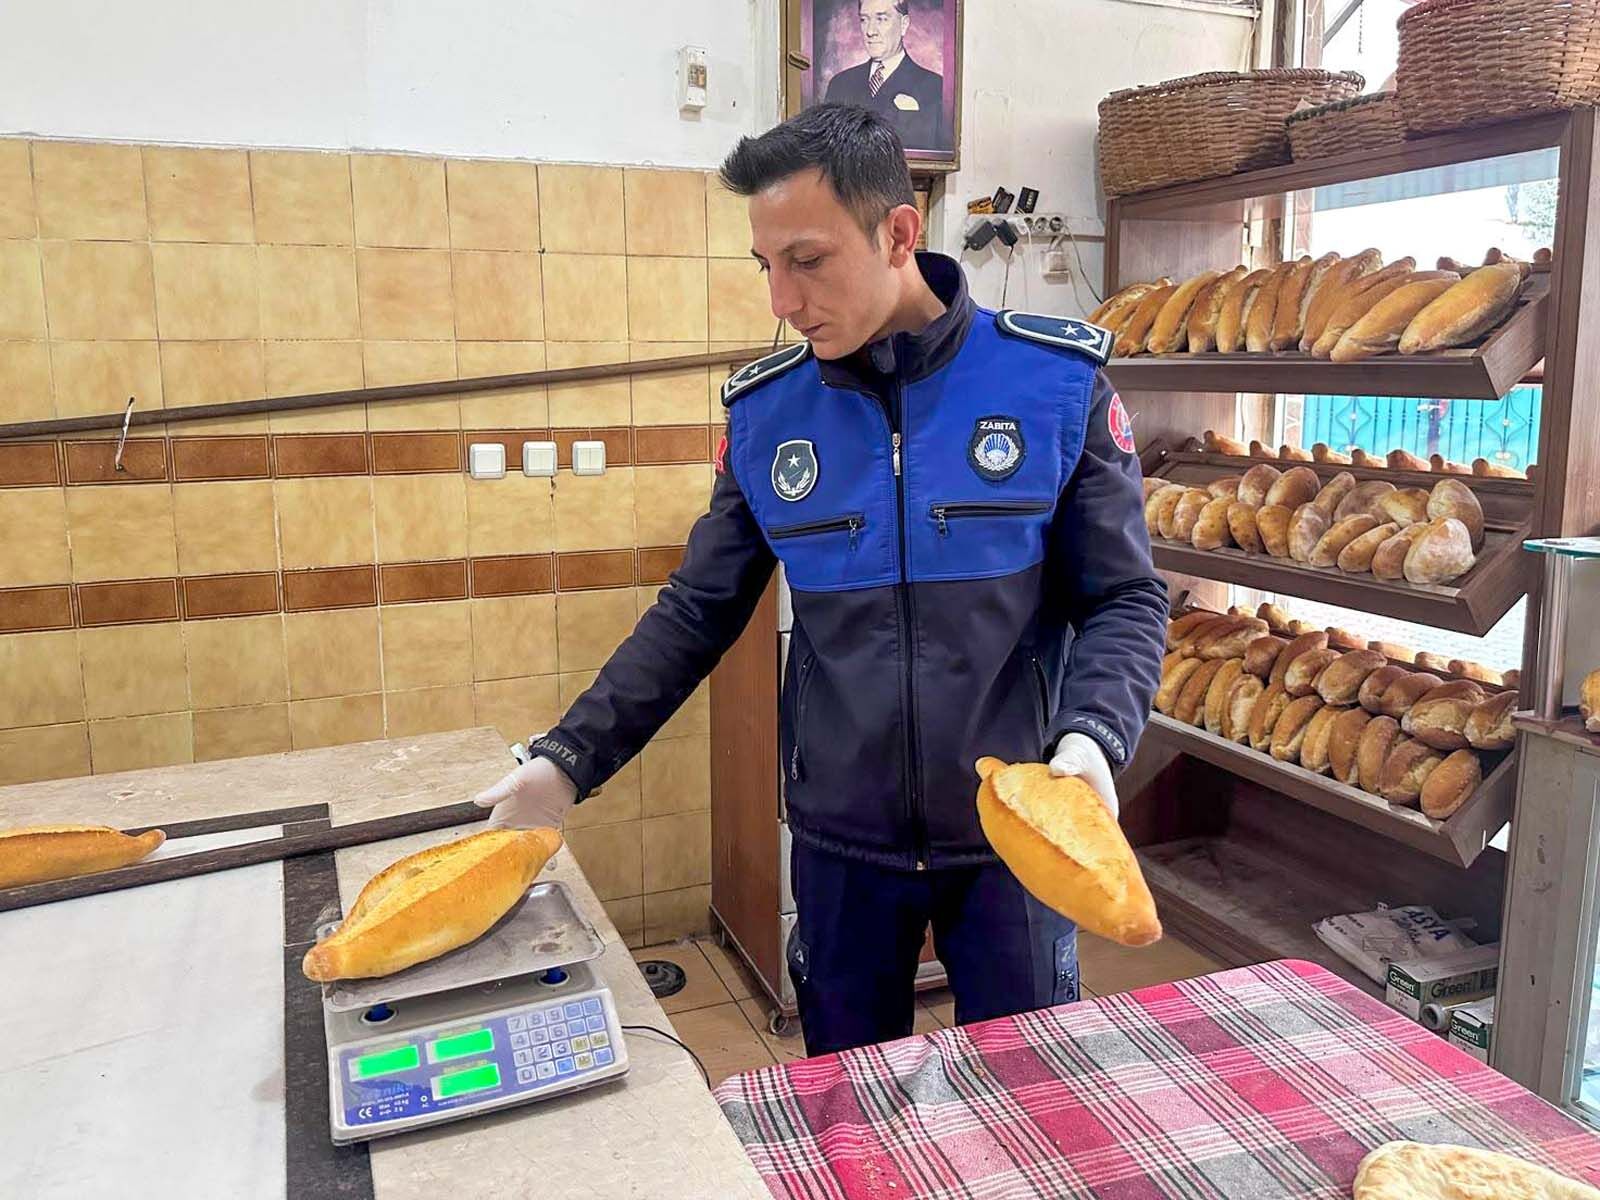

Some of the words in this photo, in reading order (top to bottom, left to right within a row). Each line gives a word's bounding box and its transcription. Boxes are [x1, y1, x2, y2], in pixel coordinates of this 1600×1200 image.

[979, 421, 1017, 431] ZABITA
[1071, 716, 1126, 761] ZABITA
[1402, 910, 1451, 941] ASYA
[1389, 970, 1415, 992] Green
[1431, 981, 1471, 998] Green
[538, 1047, 548, 1058] 2
[557, 1043, 567, 1054] 3
